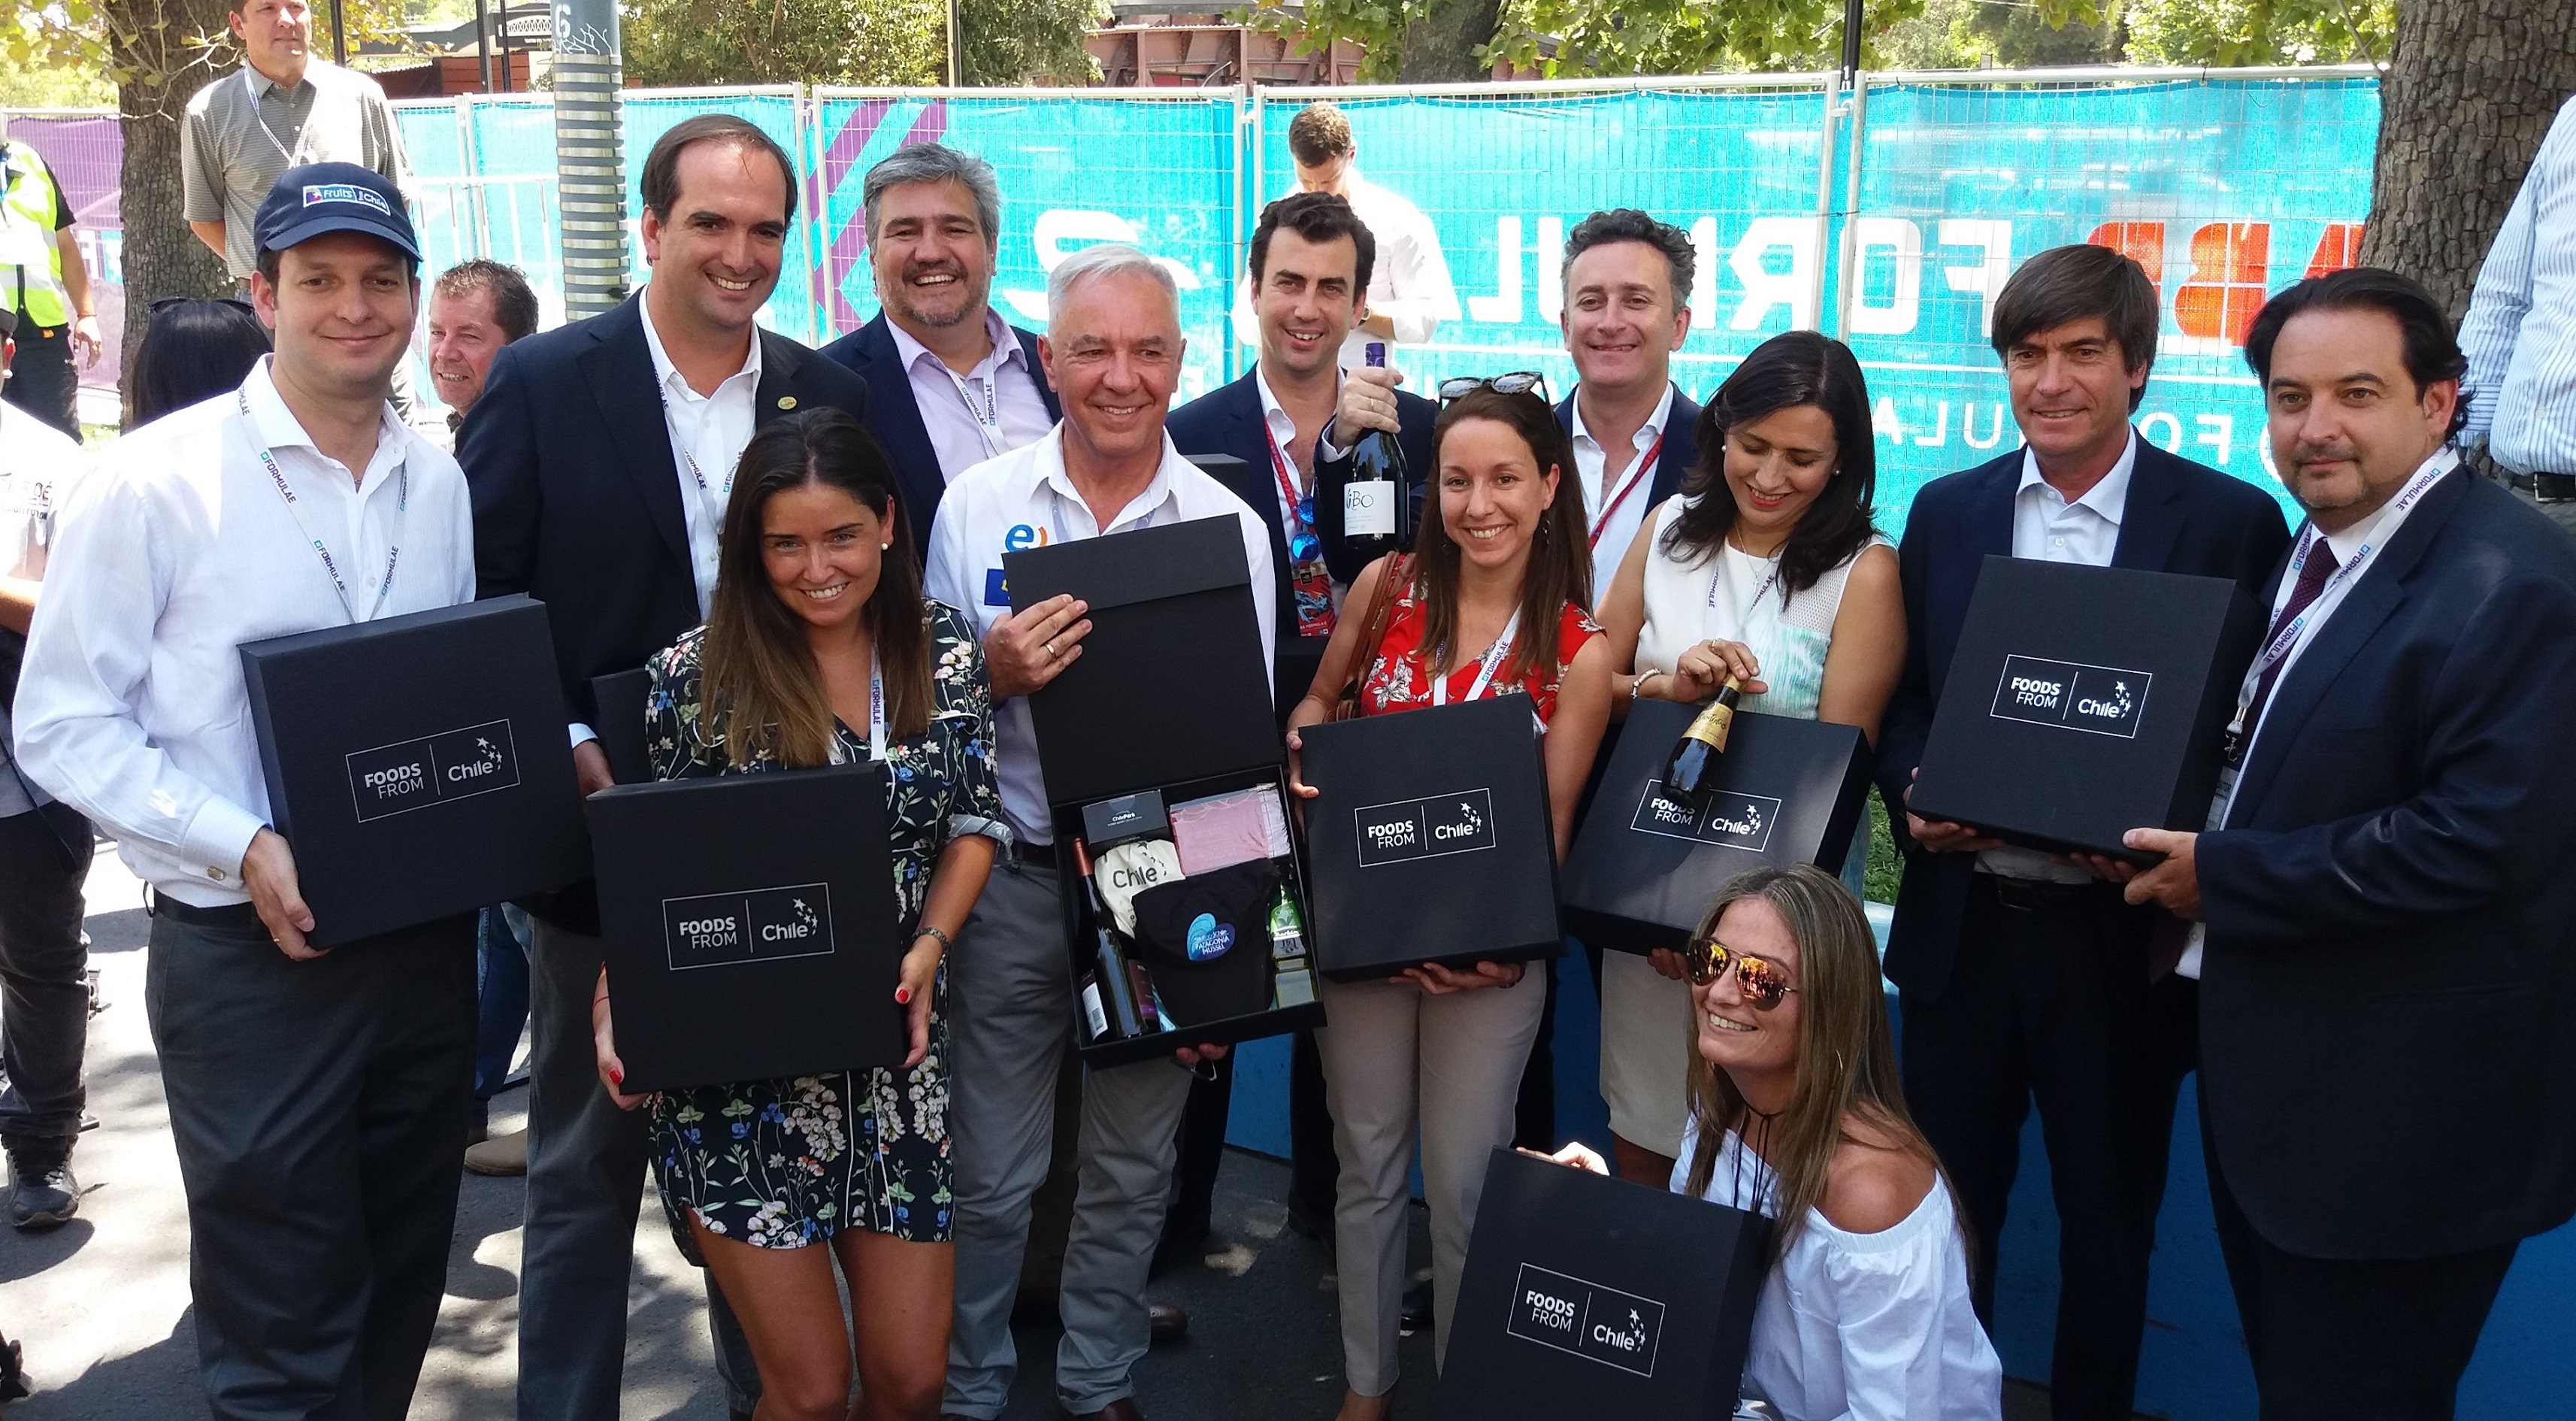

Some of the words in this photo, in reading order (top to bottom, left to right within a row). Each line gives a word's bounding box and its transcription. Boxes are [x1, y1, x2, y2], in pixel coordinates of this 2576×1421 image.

[555, 5, 571, 38] 6
[323, 188, 353, 198] Fruits
[364, 192, 387, 210] Chile
[264, 459, 297, 504] FORMULAE
[2395, 472, 2436, 511] FORMULAE
[318, 547, 346, 592] FORMULAE
[383, 545, 399, 589] FORMULAE
[2263, 623, 2299, 663] FORMULAE
[1485, 641, 1509, 676] FORMULAE
[2010, 677, 2062, 696] FOODS
[872, 686, 881, 725] FORMULAE
[2015, 691, 2058, 710] FROM
[2078, 698, 2120, 718] Chile
[364, 762, 422, 788] FOODS
[447, 759, 494, 782] Chile
[377, 776, 425, 799] FROM
[1367, 820, 1414, 838] FOODS
[1654, 810, 1694, 826] FROM
[1712, 817, 1751, 835] Chile
[1377, 832, 1415, 850] FROM
[1434, 823, 1473, 840] Chile
[1112, 866, 1158, 889] Chile
[679, 917, 736, 936] FOODS
[761, 922, 809, 941] Chile
[692, 931, 738, 950] FROM
[1525, 1289, 1576, 1317] FOODS
[1531, 1307, 1573, 1333] FROM
[1593, 1324, 1635, 1352] Chile
